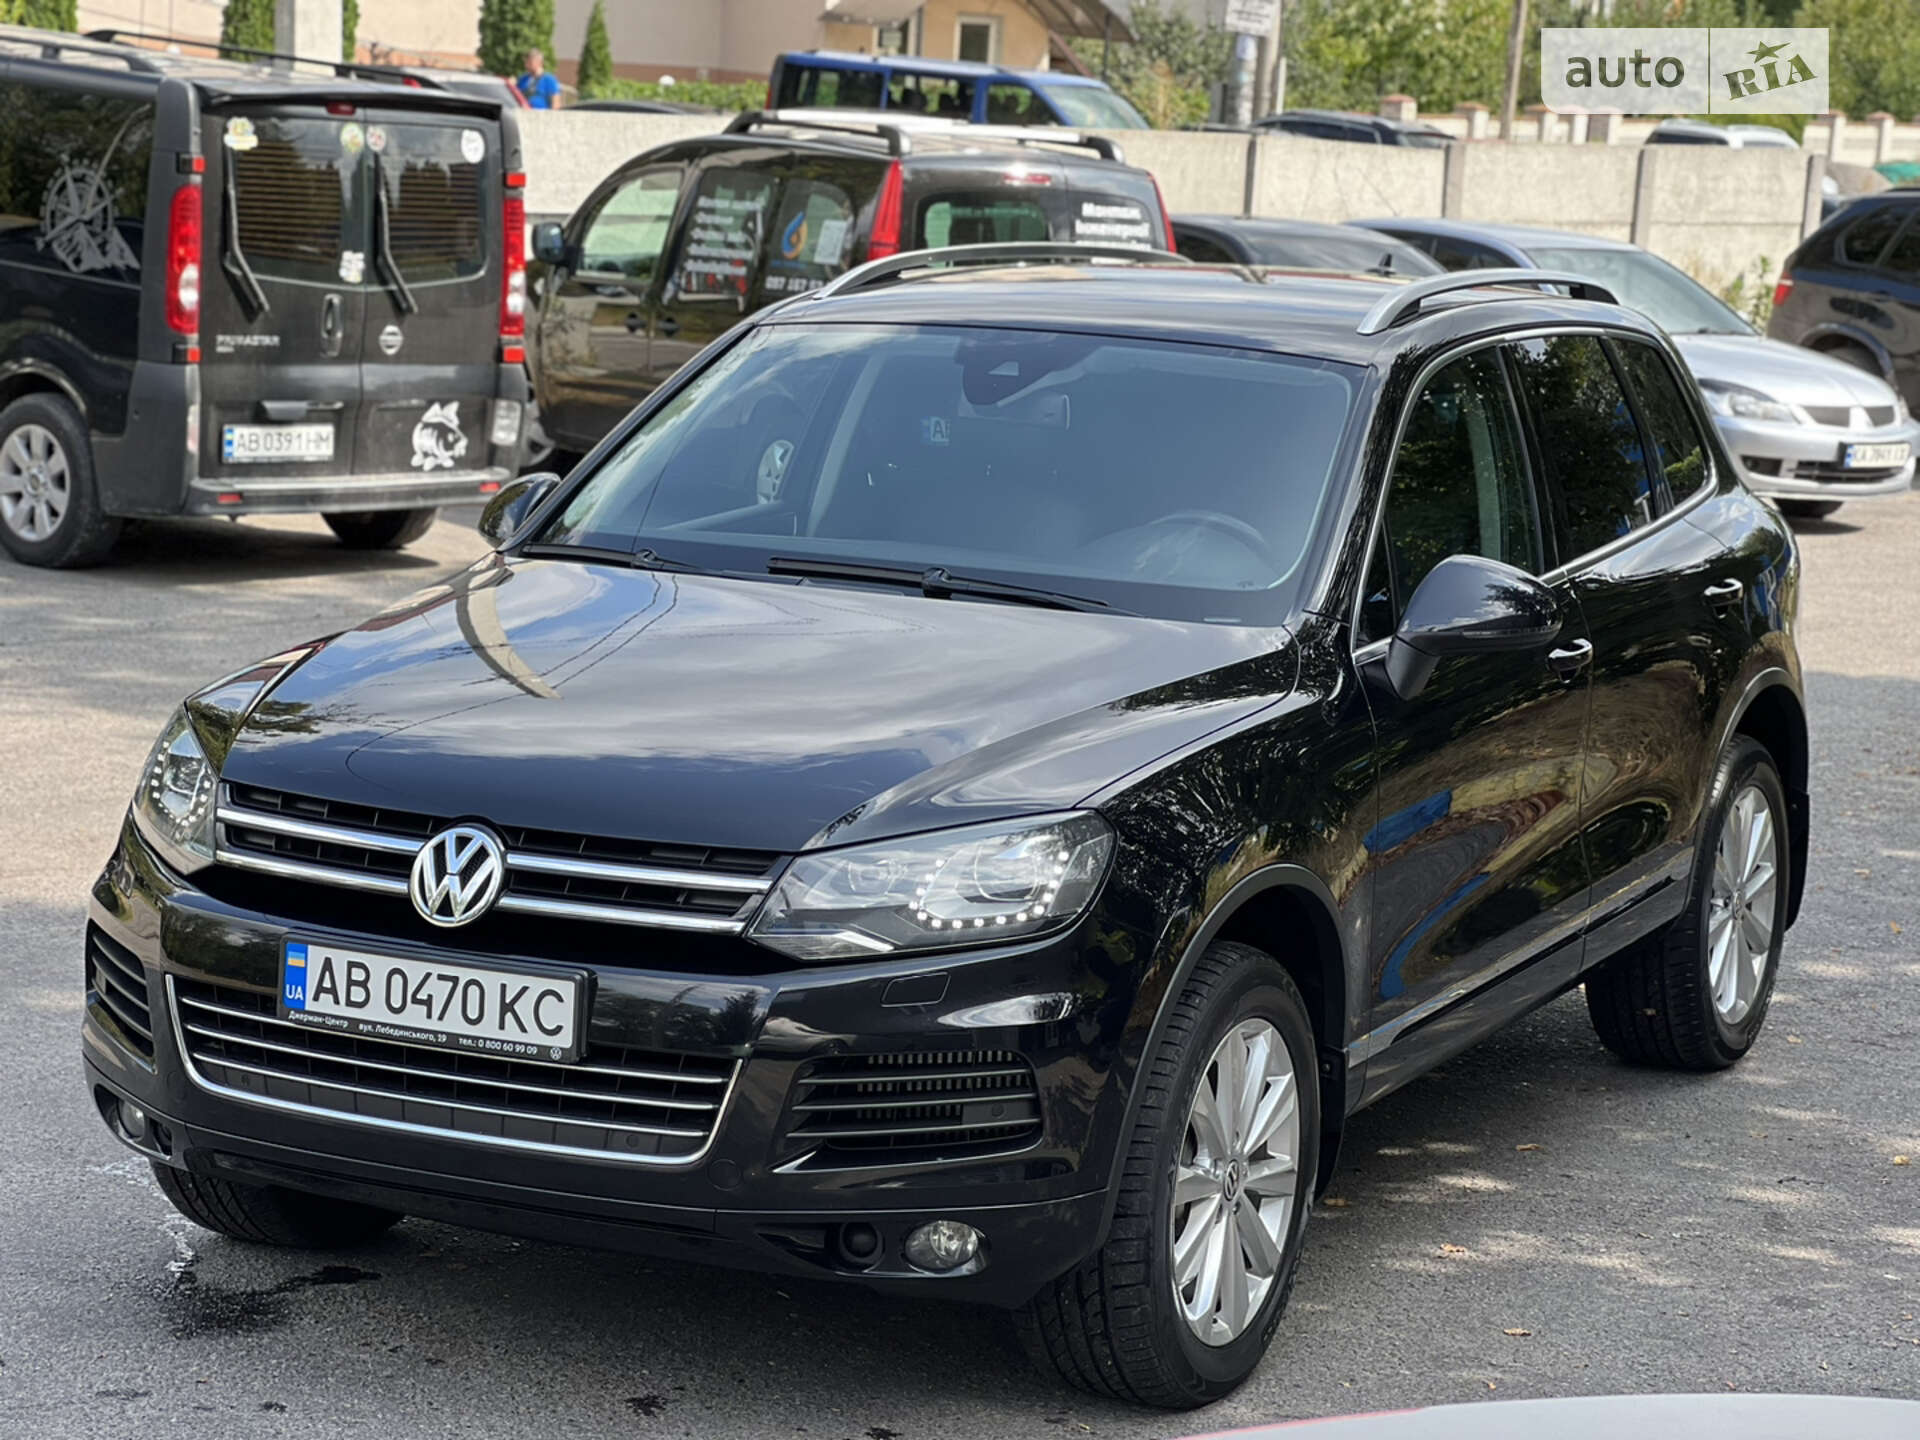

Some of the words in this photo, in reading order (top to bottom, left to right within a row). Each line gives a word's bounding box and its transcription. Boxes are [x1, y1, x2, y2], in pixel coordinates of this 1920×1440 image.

[237, 432, 260, 452] AB
[263, 432, 302, 452] 0391
[285, 984, 304, 1001] UA
[312, 956, 371, 1009] AB
[385, 967, 485, 1026] 0470
[498, 982, 564, 1037] KC
[288, 1010, 349, 1028] Джерман-Центр
[477, 1039, 484, 1048] 0
[485, 1040, 501, 1049] 800
[503, 1042, 513, 1051] 60
[514, 1044, 525, 1053] 99
[526, 1046, 538, 1055] 09
